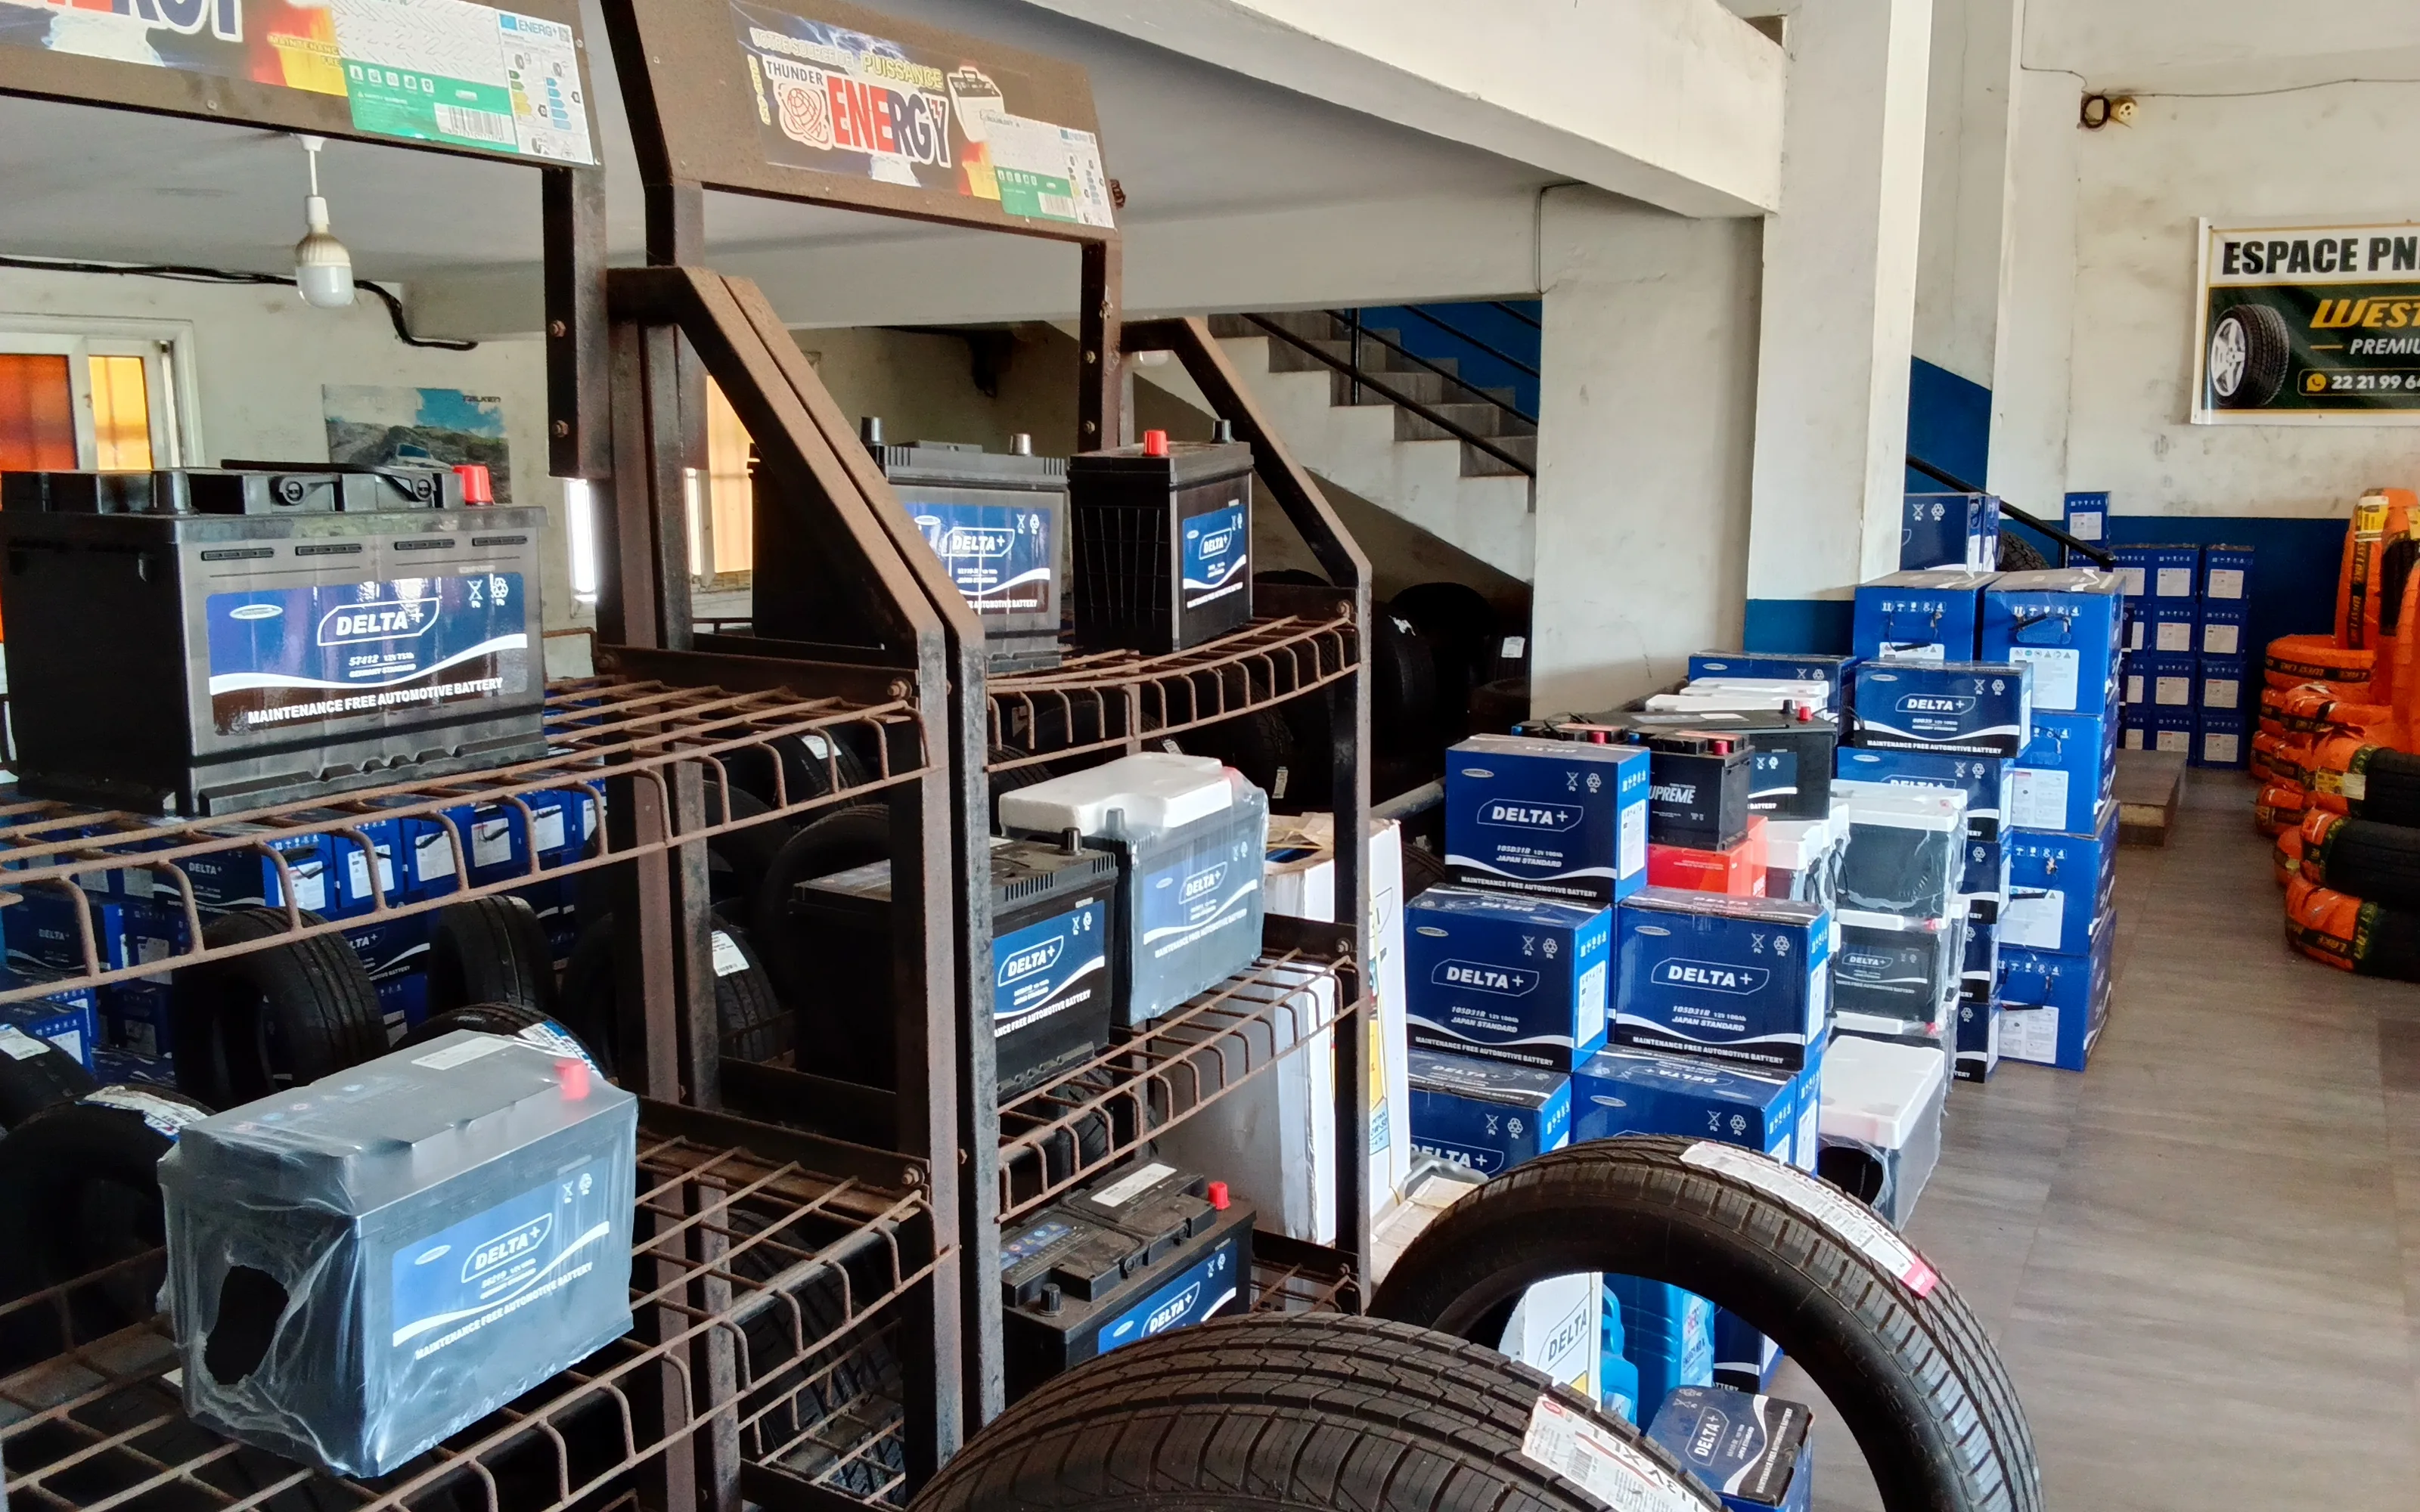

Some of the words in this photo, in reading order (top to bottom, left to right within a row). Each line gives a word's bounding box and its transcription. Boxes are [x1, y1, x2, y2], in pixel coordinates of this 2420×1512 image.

[268, 35, 340, 55] MAINTENANC
[321, 56, 340, 67] FRE
[766, 60, 823, 86] THUNDER
[864, 54, 945, 91] PUISSANCE
[827, 75, 949, 164] ENERGY
[2223, 238, 2358, 275] ESPACE
[2367, 236, 2420, 271] PN
[2332, 375, 2353, 389] 22
[2356, 375, 2375, 389] 21
[2379, 375, 2401, 389] 99
[953, 535, 1005, 550] DELTA+
[1203, 534, 1227, 554] DELTA+
[336, 611, 424, 636] DELTA+
[248, 699, 343, 724] MAINTENANCE
[345, 694, 377, 710] FREE
[378, 683, 453, 705] AUTOMOTIVE
[454, 677, 503, 695] BATTERY
[1907, 699, 1965, 711] DELTA+
[1867, 739, 1912, 748] MAINTENANCE
[1930, 744, 1972, 752] AUTOMOTIVE
[1649, 785, 1696, 804] UPREME
[1492, 806, 1568, 825] DELTA+
[188, 862, 222, 875] DELTA+
[1522, 859, 1562, 867] STANDARD
[1186, 870, 1221, 897] DELTA+
[1461, 876, 1506, 888] MAINTENANCE
[1525, 883, 1566, 894] AUTOMOTIVE
[1567, 888, 1597, 897] BATTERY
[349, 934, 377, 949] LTA+
[1008, 946, 1055, 977] DELTA+
[1850, 956, 1885, 965] DELTA+
[1446, 966, 1524, 989] DELTA+
[1668, 965, 1753, 987] DELTA+
[1011, 1016, 1027, 1031] FREE
[1027, 999, 1066, 1024] AUTOMOTIVE
[1066, 989, 1091, 1008] BATTERY
[1452, 1006, 1486, 1018] 105D31R
[1673, 1005, 1711, 1017] 105D31R
[1451, 1017, 1475, 1026] JAPAN
[1477, 1021, 1518, 1033] STANDARD
[1672, 1016, 1699, 1026] JAPAN
[1700, 1019, 1745, 1032] STANDARD
[1416, 1036, 1461, 1050] MAINTENANCE
[1462, 1044, 1478, 1053] FREE
[1479, 1047, 1522, 1061] AUTOMOTIVE
[1523, 1055, 1553, 1066] BATTERY
[1634, 1036, 1683, 1050] MAINTENANCE
[1684, 1044, 1702, 1052] FREE
[1703, 1047, 1750, 1060] AUTOMOTIVE
[1751, 1054, 1784, 1064] BATTERY
[1432, 1065, 1500, 1079] DELTA+
[475, 1226, 541, 1270] DELTA+
[415, 1319, 481, 1360] MAINTENANCE
[481, 1308, 504, 1326] FREE
[504, 1279, 557, 1314] AUTOMOTIVE
[558, 1262, 593, 1287] BATTERY
[1150, 1293, 1192, 1333] DELTA+
[1548, 1309, 1587, 1362] DELTA
[1694, 1414, 1720, 1457] DELTA+
